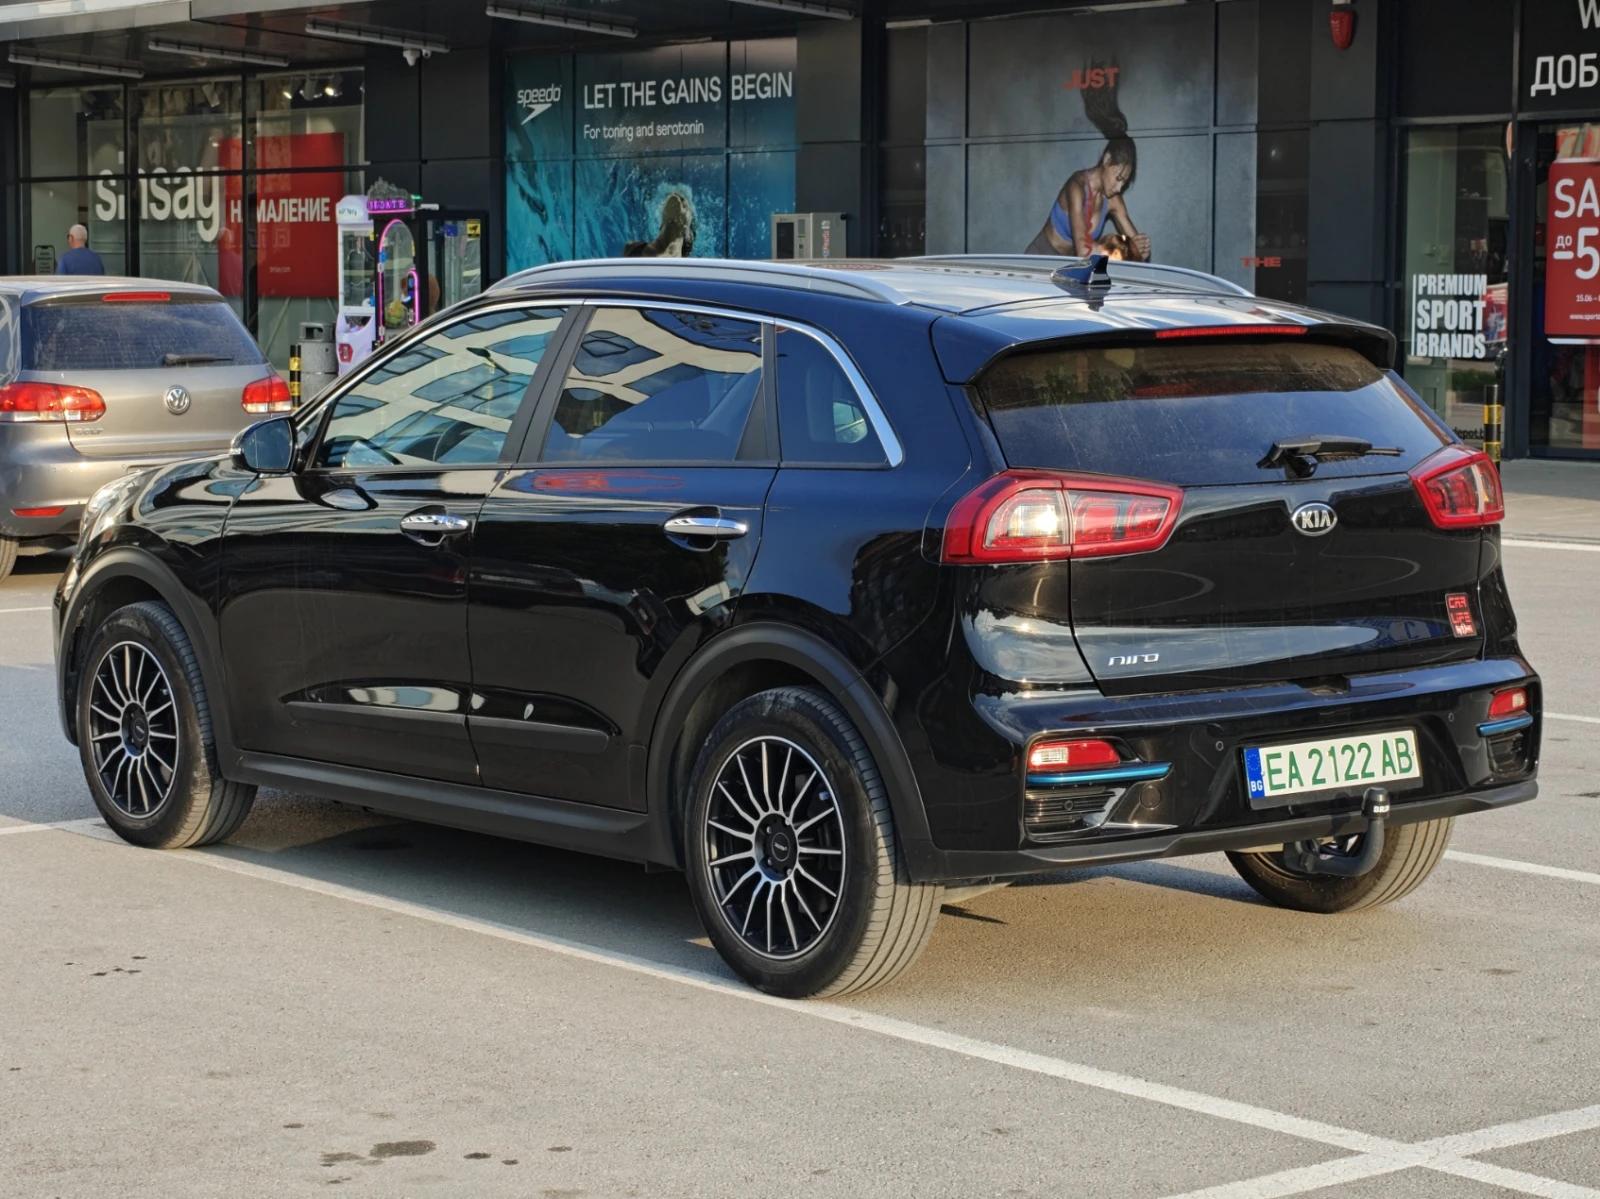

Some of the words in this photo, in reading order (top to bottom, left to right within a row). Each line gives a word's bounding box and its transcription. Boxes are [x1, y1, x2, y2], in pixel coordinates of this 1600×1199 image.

[1064, 68, 1120, 90] JUST
[1530, 53, 1599, 97] ДОБ
[517, 83, 561, 108] speedo
[584, 83, 616, 109] LET
[620, 80, 656, 107] THE
[661, 75, 721, 105] GAINS
[731, 71, 793, 101] BEGIN
[583, 124, 600, 139] For
[603, 123, 633, 141] toning
[635, 121, 654, 137] and
[656, 119, 704, 137] serotonin
[230, 198, 331, 223] НМАЛЕНИЕ
[1554, 178, 1600, 219] SA
[1240, 256, 1282, 268] THE
[1418, 274, 1487, 296] PREMIUM
[1416, 299, 1487, 331] SPORT
[1416, 333, 1486, 359] BRANDS
[1299, 509, 1333, 531] KIA
[1107, 652, 1160, 667] niro
[1265, 751, 1304, 791] EA
[1307, 742, 1375, 786] 2122
[1382, 737, 1413, 777] AB
[1251, 780, 1264, 792] BG
